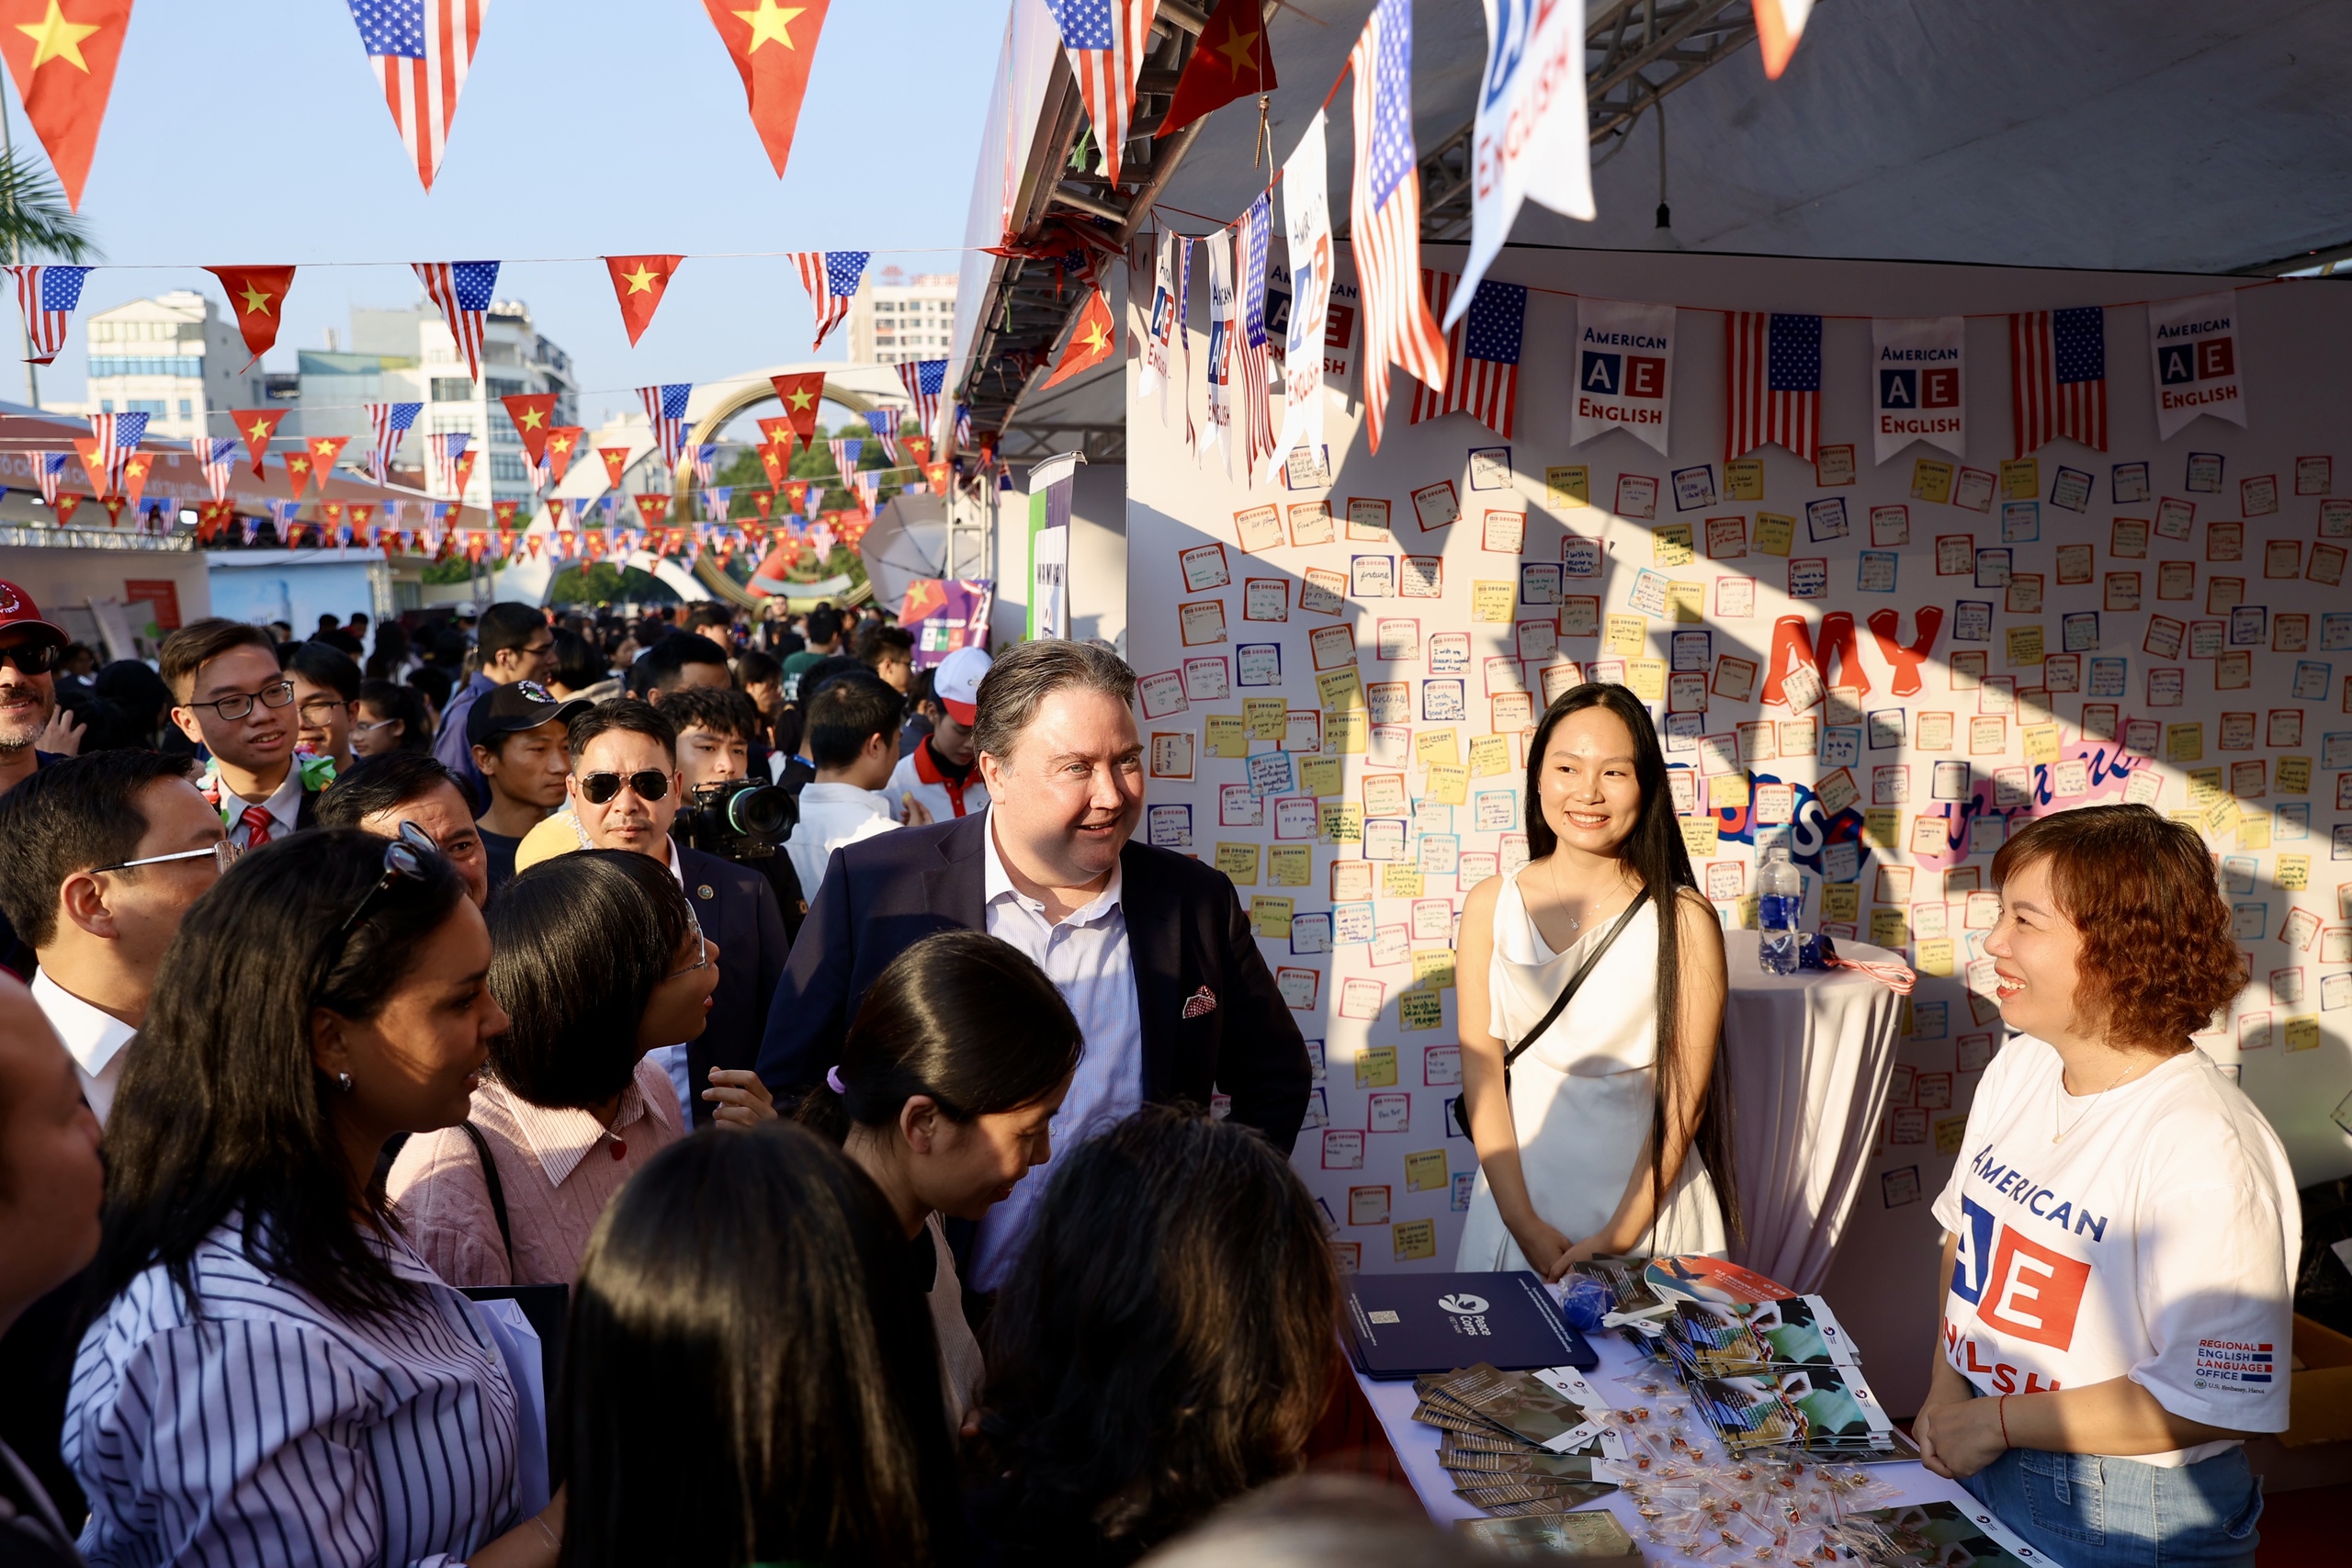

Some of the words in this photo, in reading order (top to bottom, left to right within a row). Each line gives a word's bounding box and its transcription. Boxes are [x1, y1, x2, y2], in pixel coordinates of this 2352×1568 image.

[2157, 318, 2230, 339] AMERICAN
[1584, 327, 1667, 349] AMERICAN
[1881, 346, 1958, 361] AMERICAN
[2162, 385, 2237, 409] ENGLISH
[1208, 394, 1230, 427] ENGLISH
[1579, 398, 1662, 423] ENGLISH
[1881, 415, 1960, 434] ENGLISH
[1428, 488, 1449, 498] DREAMS
[1250, 510, 1272, 518] DREAMS
[1196, 549, 1219, 558] DREAMS
[1319, 574, 1342, 582] DREAMS
[1361, 571, 1389, 581] fortune
[1325, 628, 1347, 637] DREAMS
[1759, 605, 1944, 706] MY
[1154, 675, 1176, 684] DREAMS
[1331, 672, 1353, 682] DREAMS
[1430, 734, 1452, 742] DREAMS
[1972, 1144, 2108, 1242] AMERICAN
[1460, 1315, 1477, 1336] Corps
[1473, 1315, 1491, 1336] Peace
[2199, 1339, 2256, 1351] REGIONAL
[2199, 1348, 2249, 1361] ENGLISH
[2197, 1359, 2262, 1371] LANGUAGE
[2196, 1369, 2237, 1380] OFFICE
[2222, 1385, 2246, 1393] Embassy,
